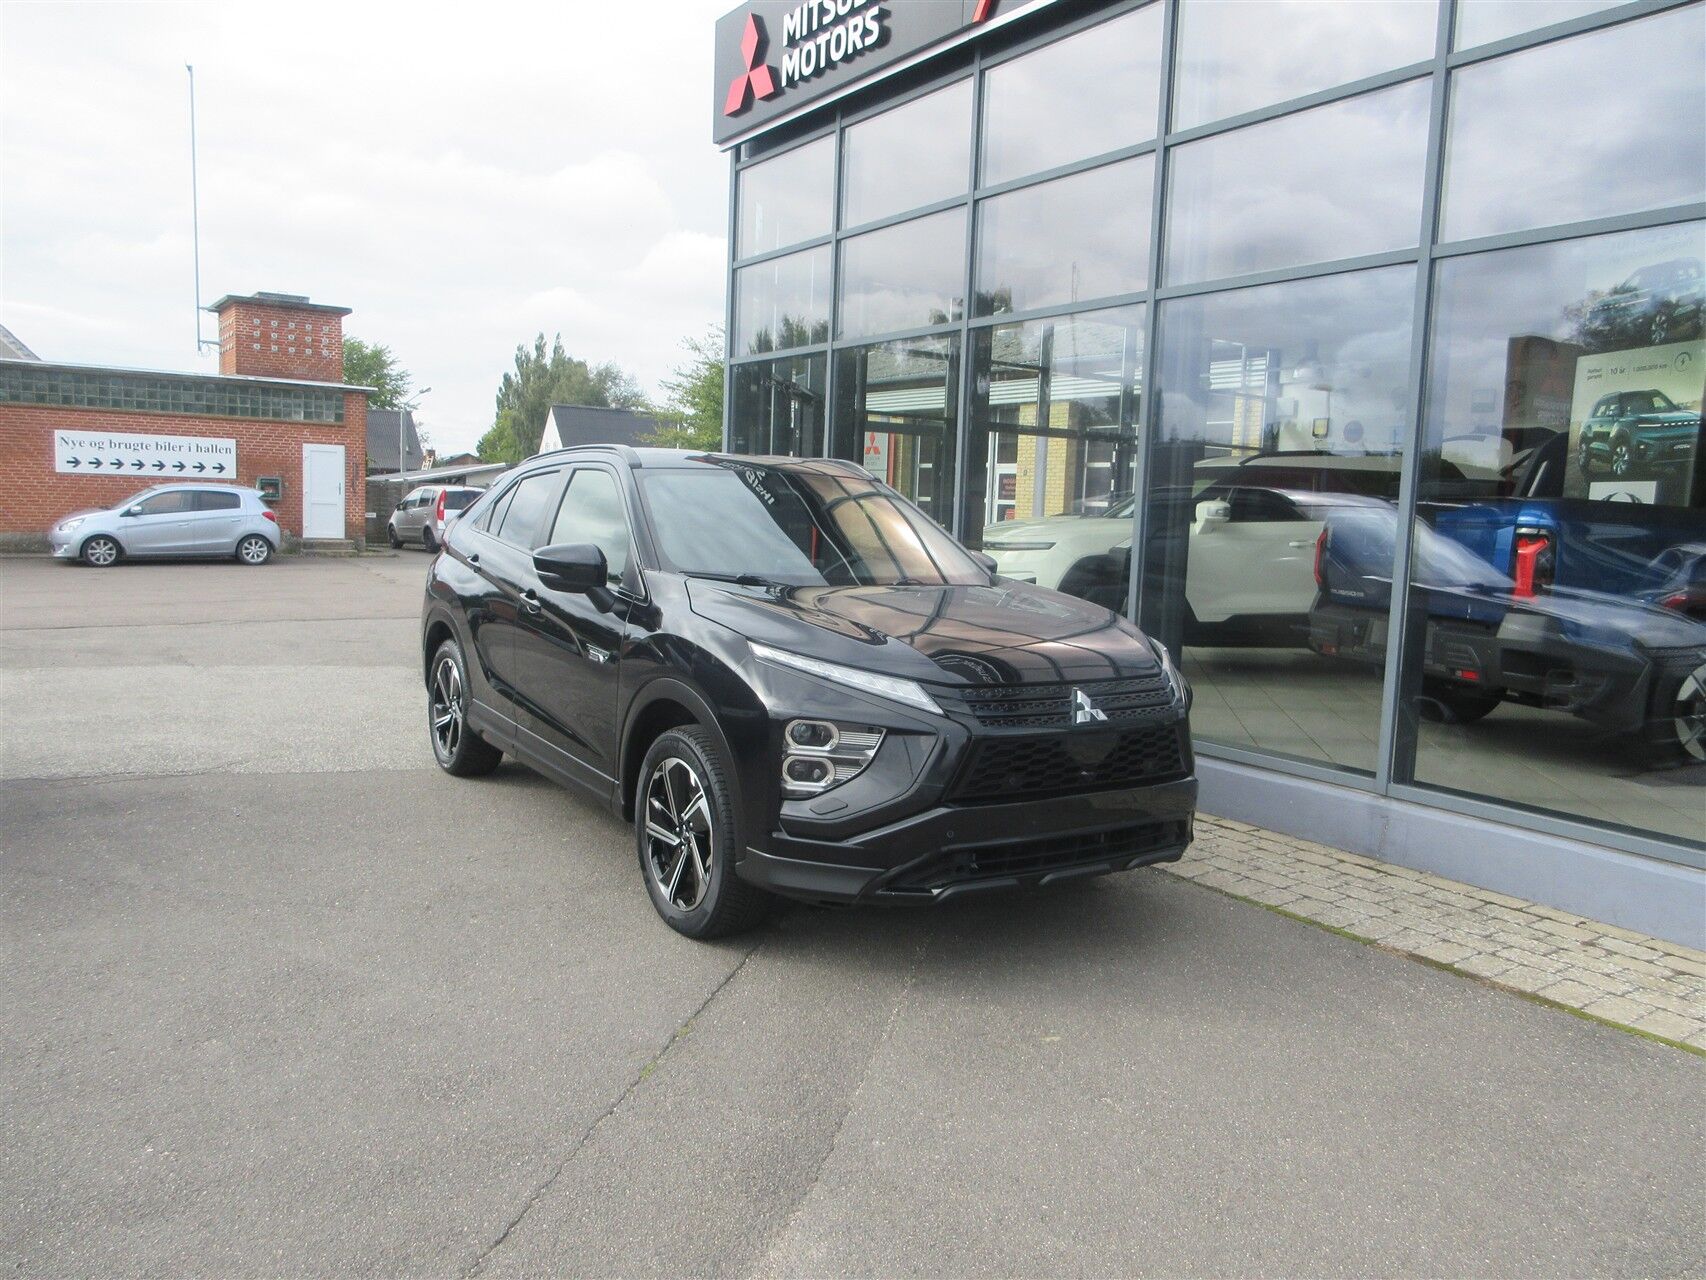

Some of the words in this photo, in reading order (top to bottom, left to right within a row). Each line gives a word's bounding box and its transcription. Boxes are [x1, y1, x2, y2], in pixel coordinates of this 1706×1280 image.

[781, 5, 880, 88] MOTORS
[60, 436, 86, 450] Nye
[89, 440, 105, 451] og
[109, 439, 152, 452] brugte
[155, 441, 185, 452] biler
[196, 443, 232, 454] hallen
